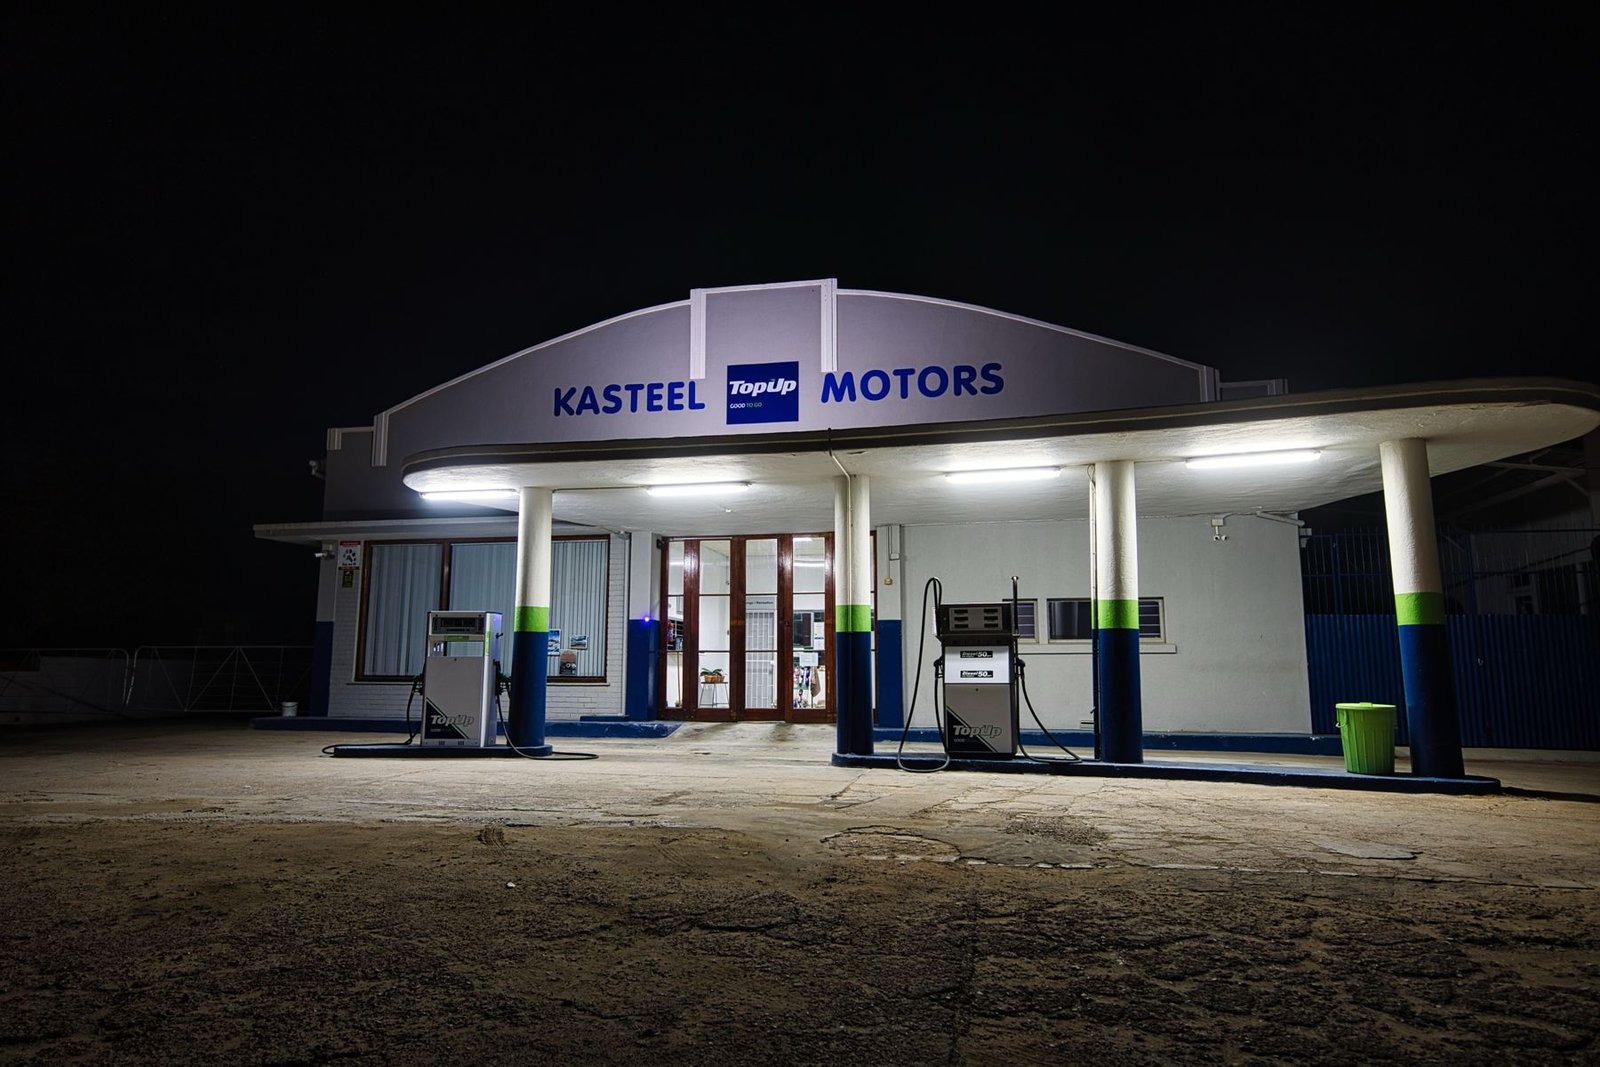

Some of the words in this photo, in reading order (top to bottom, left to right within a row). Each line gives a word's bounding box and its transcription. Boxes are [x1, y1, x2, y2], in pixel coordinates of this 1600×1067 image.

[554, 381, 705, 417] KASTEEL
[820, 362, 1004, 403] MOTORS
[729, 378, 797, 397] TopUp
[430, 714, 474, 727] TopUp
[952, 724, 1002, 738] TopUp
